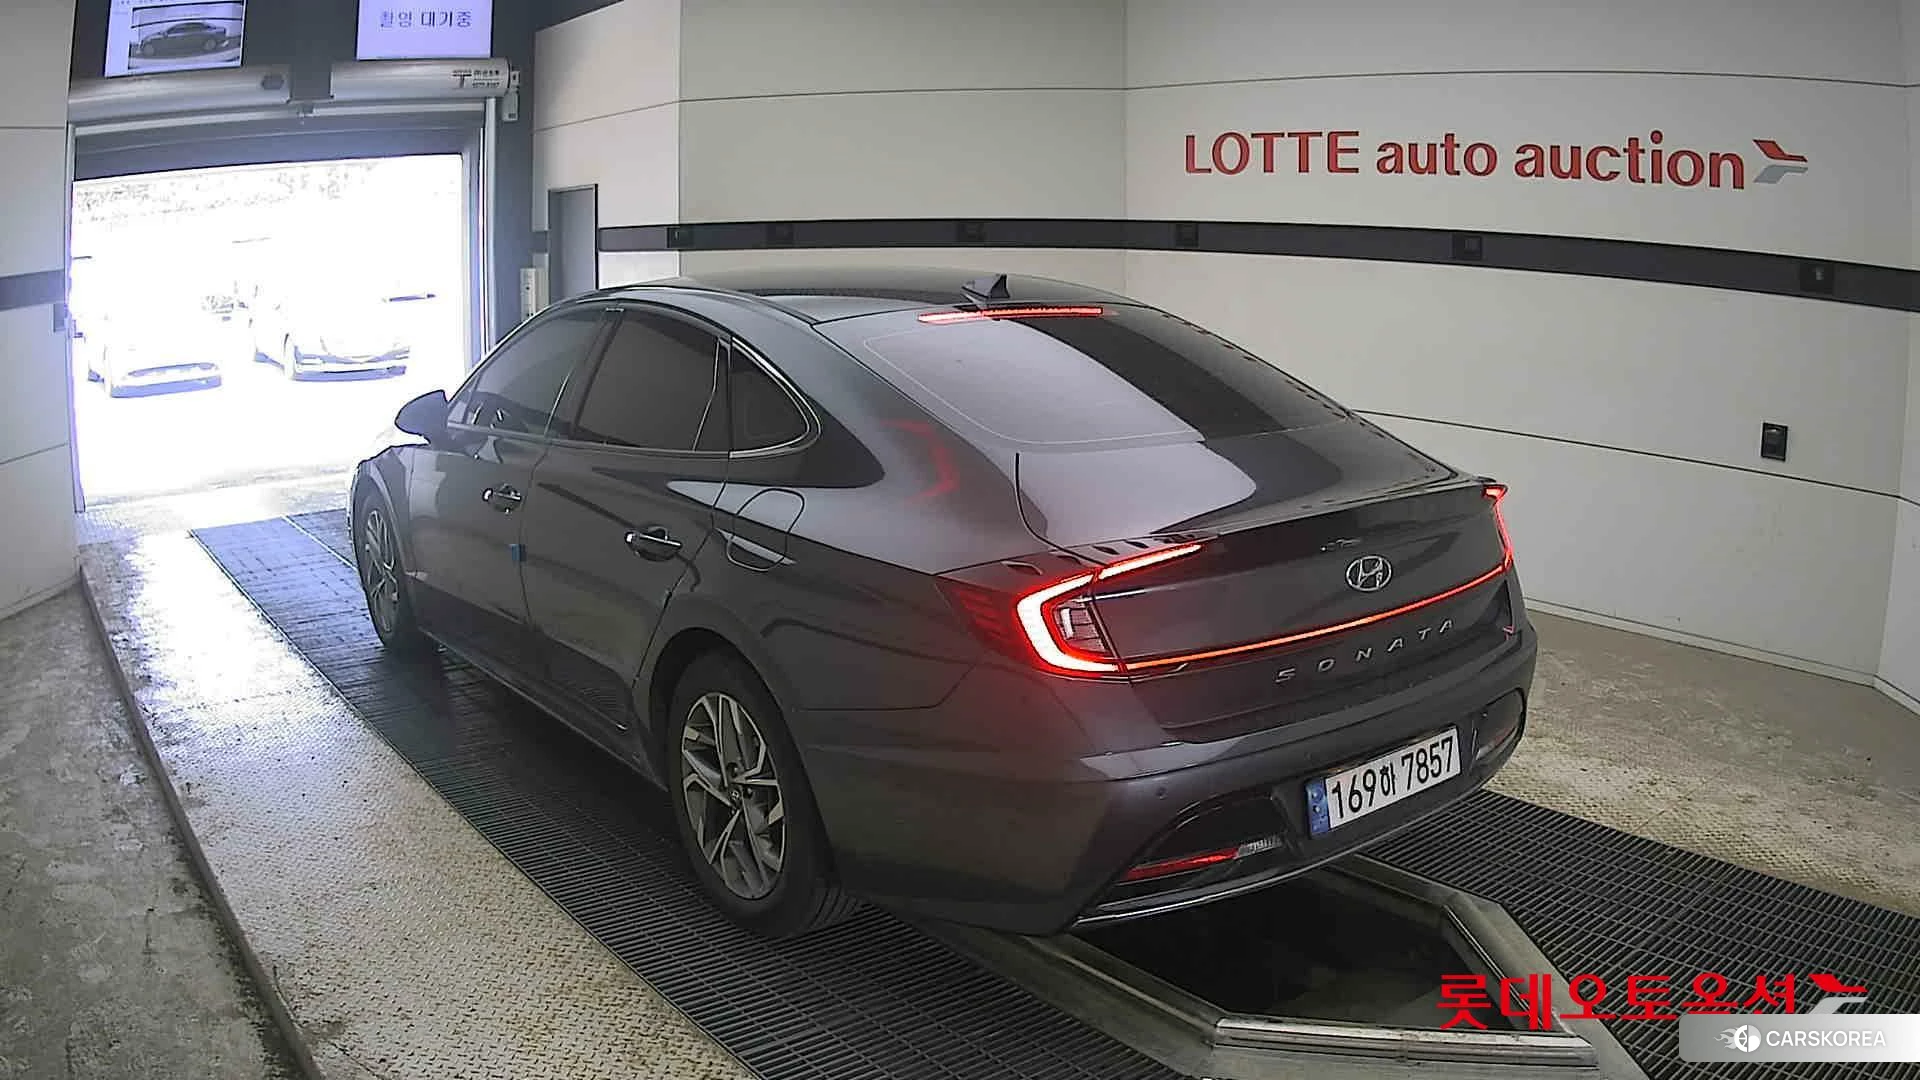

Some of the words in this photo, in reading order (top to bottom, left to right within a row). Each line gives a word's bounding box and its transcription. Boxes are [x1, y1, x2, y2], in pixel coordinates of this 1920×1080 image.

[421, 11, 472, 28] 대기중
[1185, 131, 1360, 174] LOTTE
[1376, 133, 1498, 177] auto
[1515, 130, 1745, 190] auction
[1274, 618, 1454, 683] SONATA
[1331, 761, 1396, 819] 169하
[1401, 736, 1454, 791] 7857
